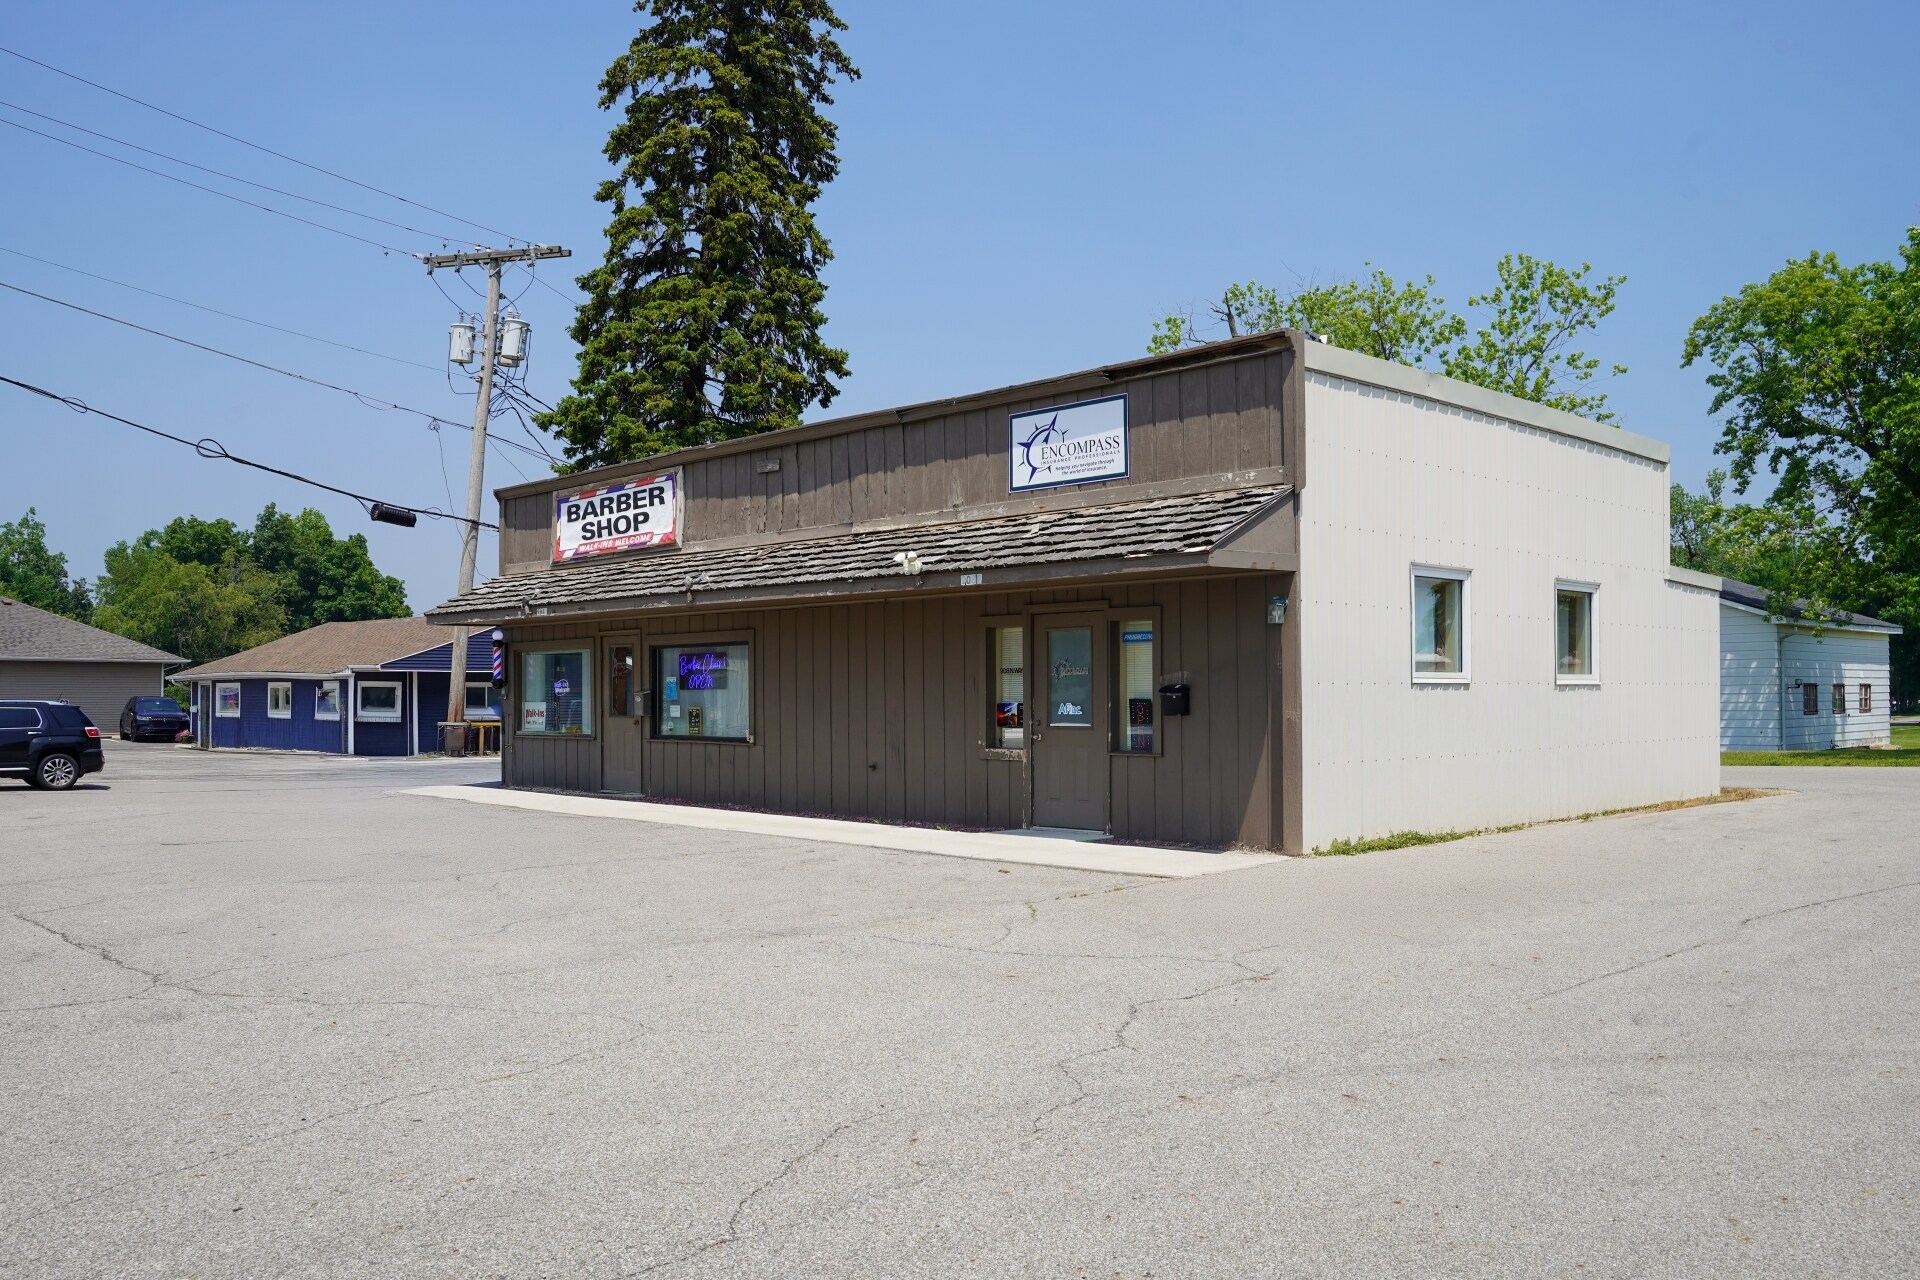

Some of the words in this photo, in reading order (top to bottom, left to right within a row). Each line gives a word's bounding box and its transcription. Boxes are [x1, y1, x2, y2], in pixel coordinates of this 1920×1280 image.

[1040, 457, 1071, 466] INSURANCE
[1074, 450, 1121, 461] PROFESSIONALS
[1041, 435, 1120, 460] ENCOMPASS
[566, 486, 666, 523] BARBER
[581, 511, 650, 541] SHOP
[579, 540, 614, 552] WALK-INS
[615, 533, 652, 546] WELCOME
